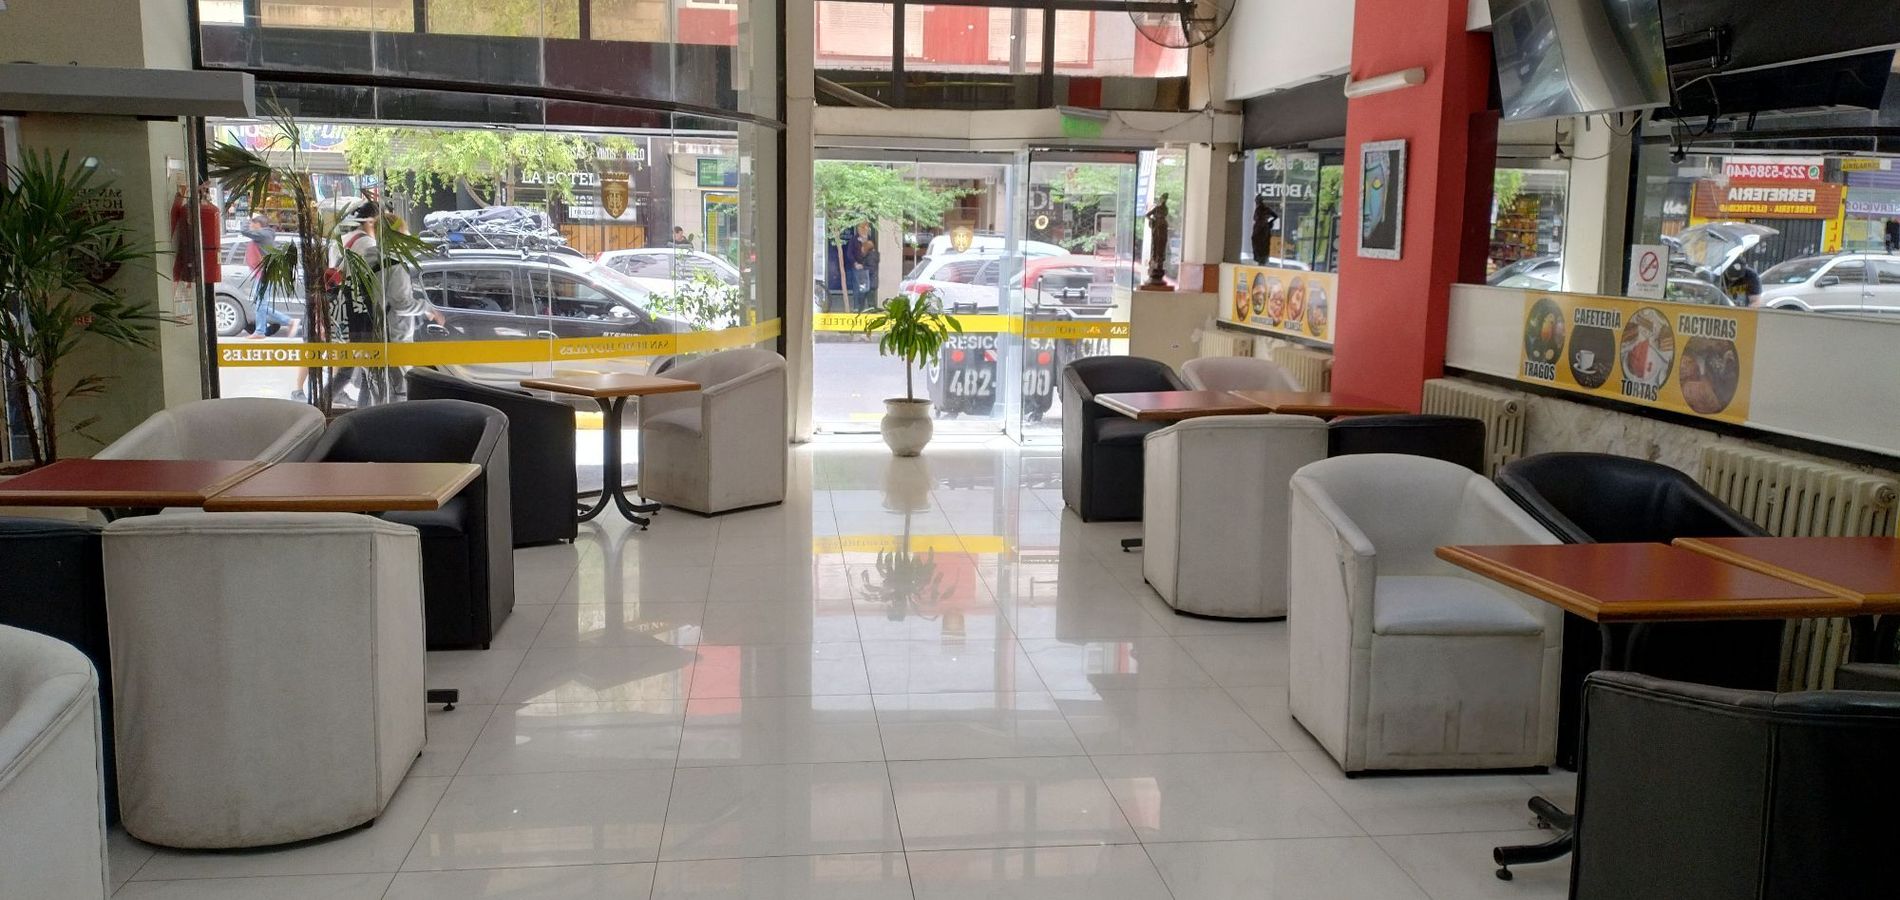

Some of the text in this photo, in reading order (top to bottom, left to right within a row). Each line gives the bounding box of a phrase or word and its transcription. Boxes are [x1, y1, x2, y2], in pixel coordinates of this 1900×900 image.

[521, 171, 543, 184] LA
[1574, 308, 1621, 329] CAFETERÍA
[1678, 315, 1737, 339] FACTURAS
[1524, 360, 1556, 381] TRAGOS
[1620, 378, 1658, 402] TORTAS
